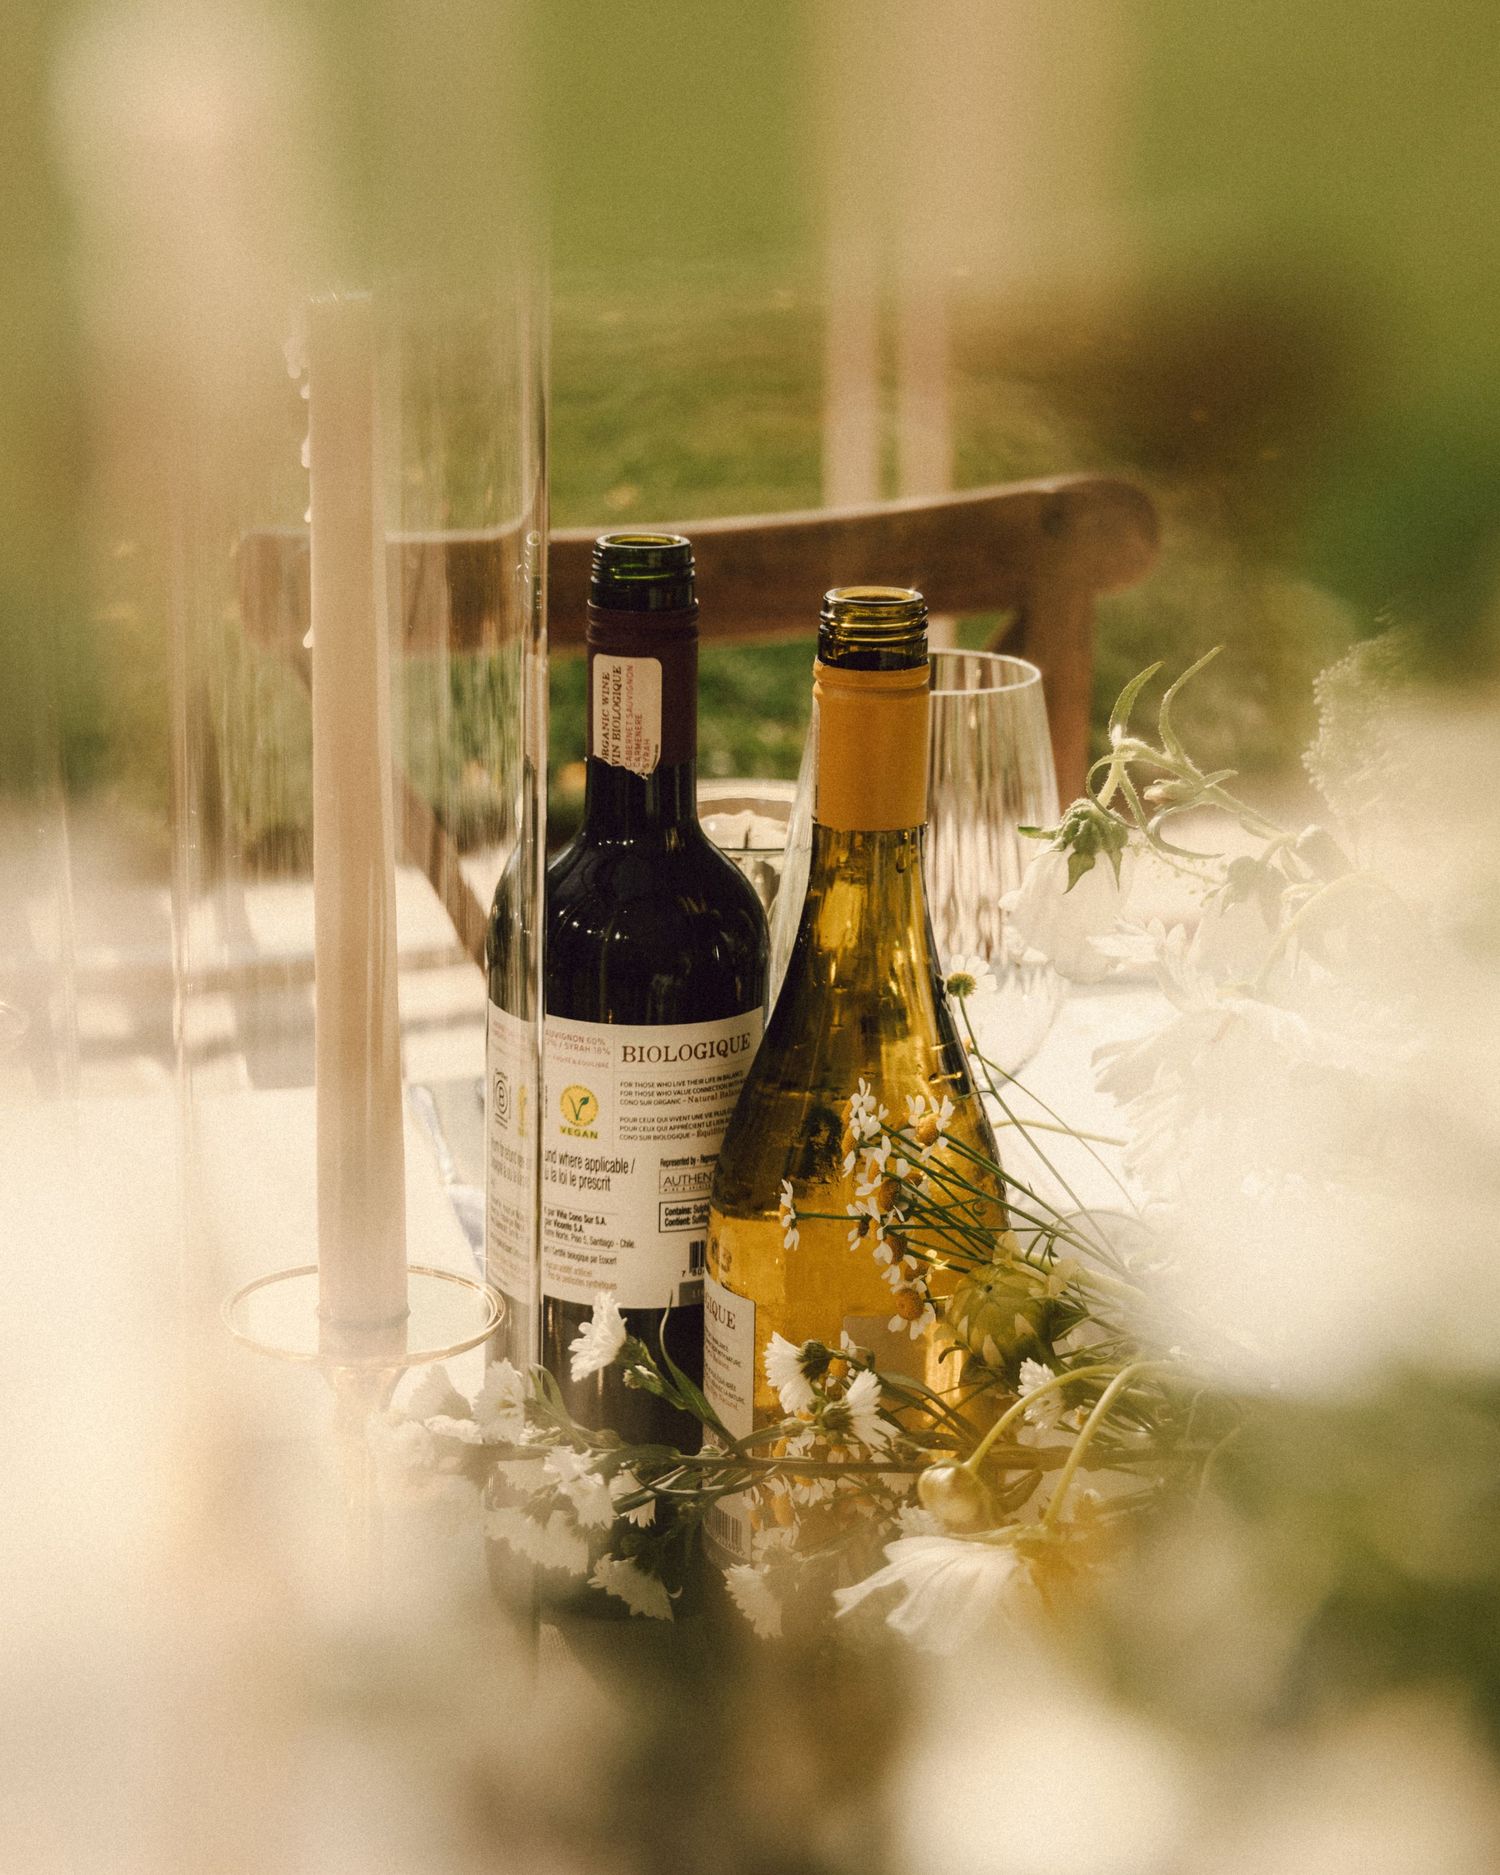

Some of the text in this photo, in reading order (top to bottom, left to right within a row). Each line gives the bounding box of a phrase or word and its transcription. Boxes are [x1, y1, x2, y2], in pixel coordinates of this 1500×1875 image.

[602, 672, 610, 760] RGANIC WINE
[611, 665, 622, 766] VIN BIOLOGIQUE
[624, 664, 634, 768] CABERNET SAUVIGNON
[564, 1042, 590, 1053] SYRAH
[622, 1032, 750, 1062] BIOLOGIQUE
[672, 1088, 692, 1096] VALUE
[692, 1083, 728, 1094] CONNECTION
[673, 1080, 686, 1088] LIVE
[687, 1078, 704, 1087] THEIR
[654, 1098, 681, 1106] ORGANIC
[688, 1092, 718, 1104] Natural
[670, 1114, 691, 1122] VIVENT
[691, 1113, 704, 1121] UNE
[560, 1126, 598, 1140] VEGAN
[652, 1132, 690, 1141] BIOLOGIQUE
[559, 1151, 582, 1170] where
[584, 1156, 629, 1174] applicable
[660, 1156, 690, 1168] Represented
[690, 1154, 696, 1167] by
[550, 1168, 557, 1182] la
[559, 1168, 568, 1186] loi
[570, 1170, 577, 1188] le
[578, 1176, 611, 1192] prescrit
[664, 1207, 692, 1217] Contains:
[590, 1236, 615, 1249] Santiago
